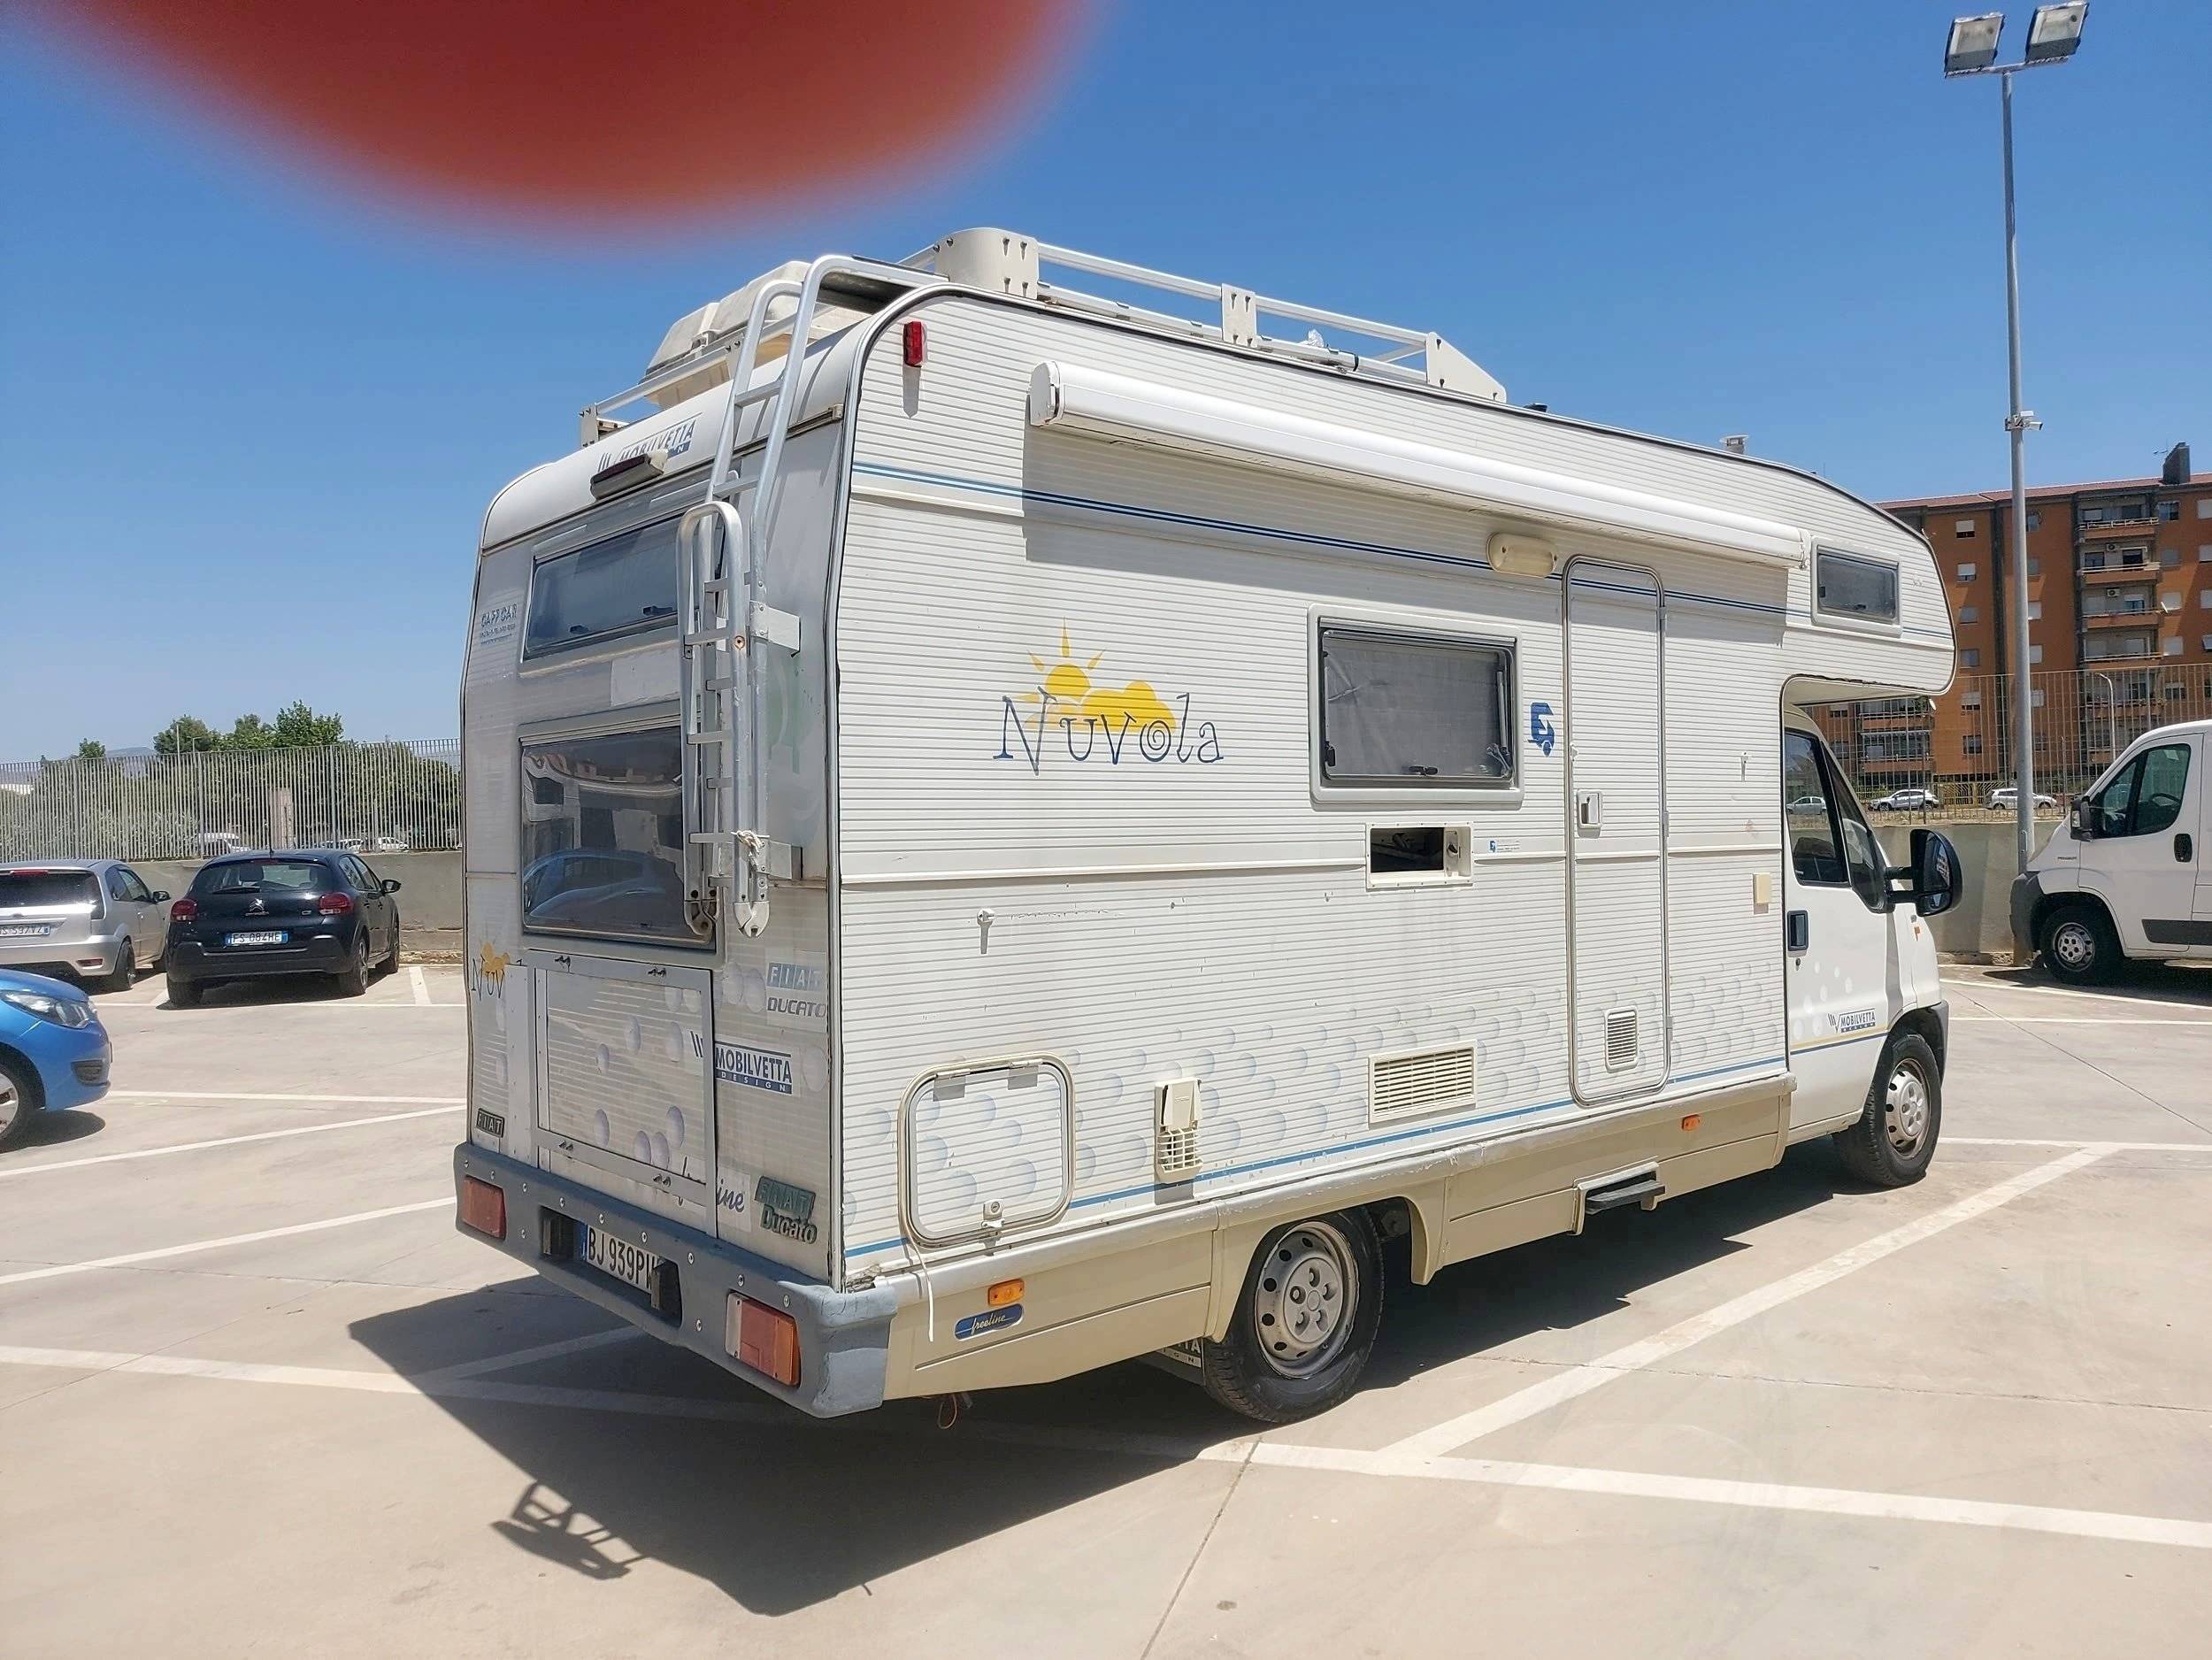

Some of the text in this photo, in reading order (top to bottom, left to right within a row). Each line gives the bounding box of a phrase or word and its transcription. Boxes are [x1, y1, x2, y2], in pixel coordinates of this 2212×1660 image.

[993, 686, 1224, 776] Nuvola
[471, 954, 505, 1002] Nuv
[769, 965, 822, 988] FIAT
[767, 996, 826, 1018] DUCATO
[1840, 1011, 1875, 1028] MOBILVETTA
[714, 1047, 792, 1083] MOBILVETTA
[721, 1072, 786, 1092] DESIGN
[478, 1112, 503, 1134] FIAT
[758, 1181, 810, 1215] FIAT
[760, 1203, 818, 1244] Ducato
[588, 1227, 605, 1265] BJ
[970, 1312, 1007, 1335] freeline
